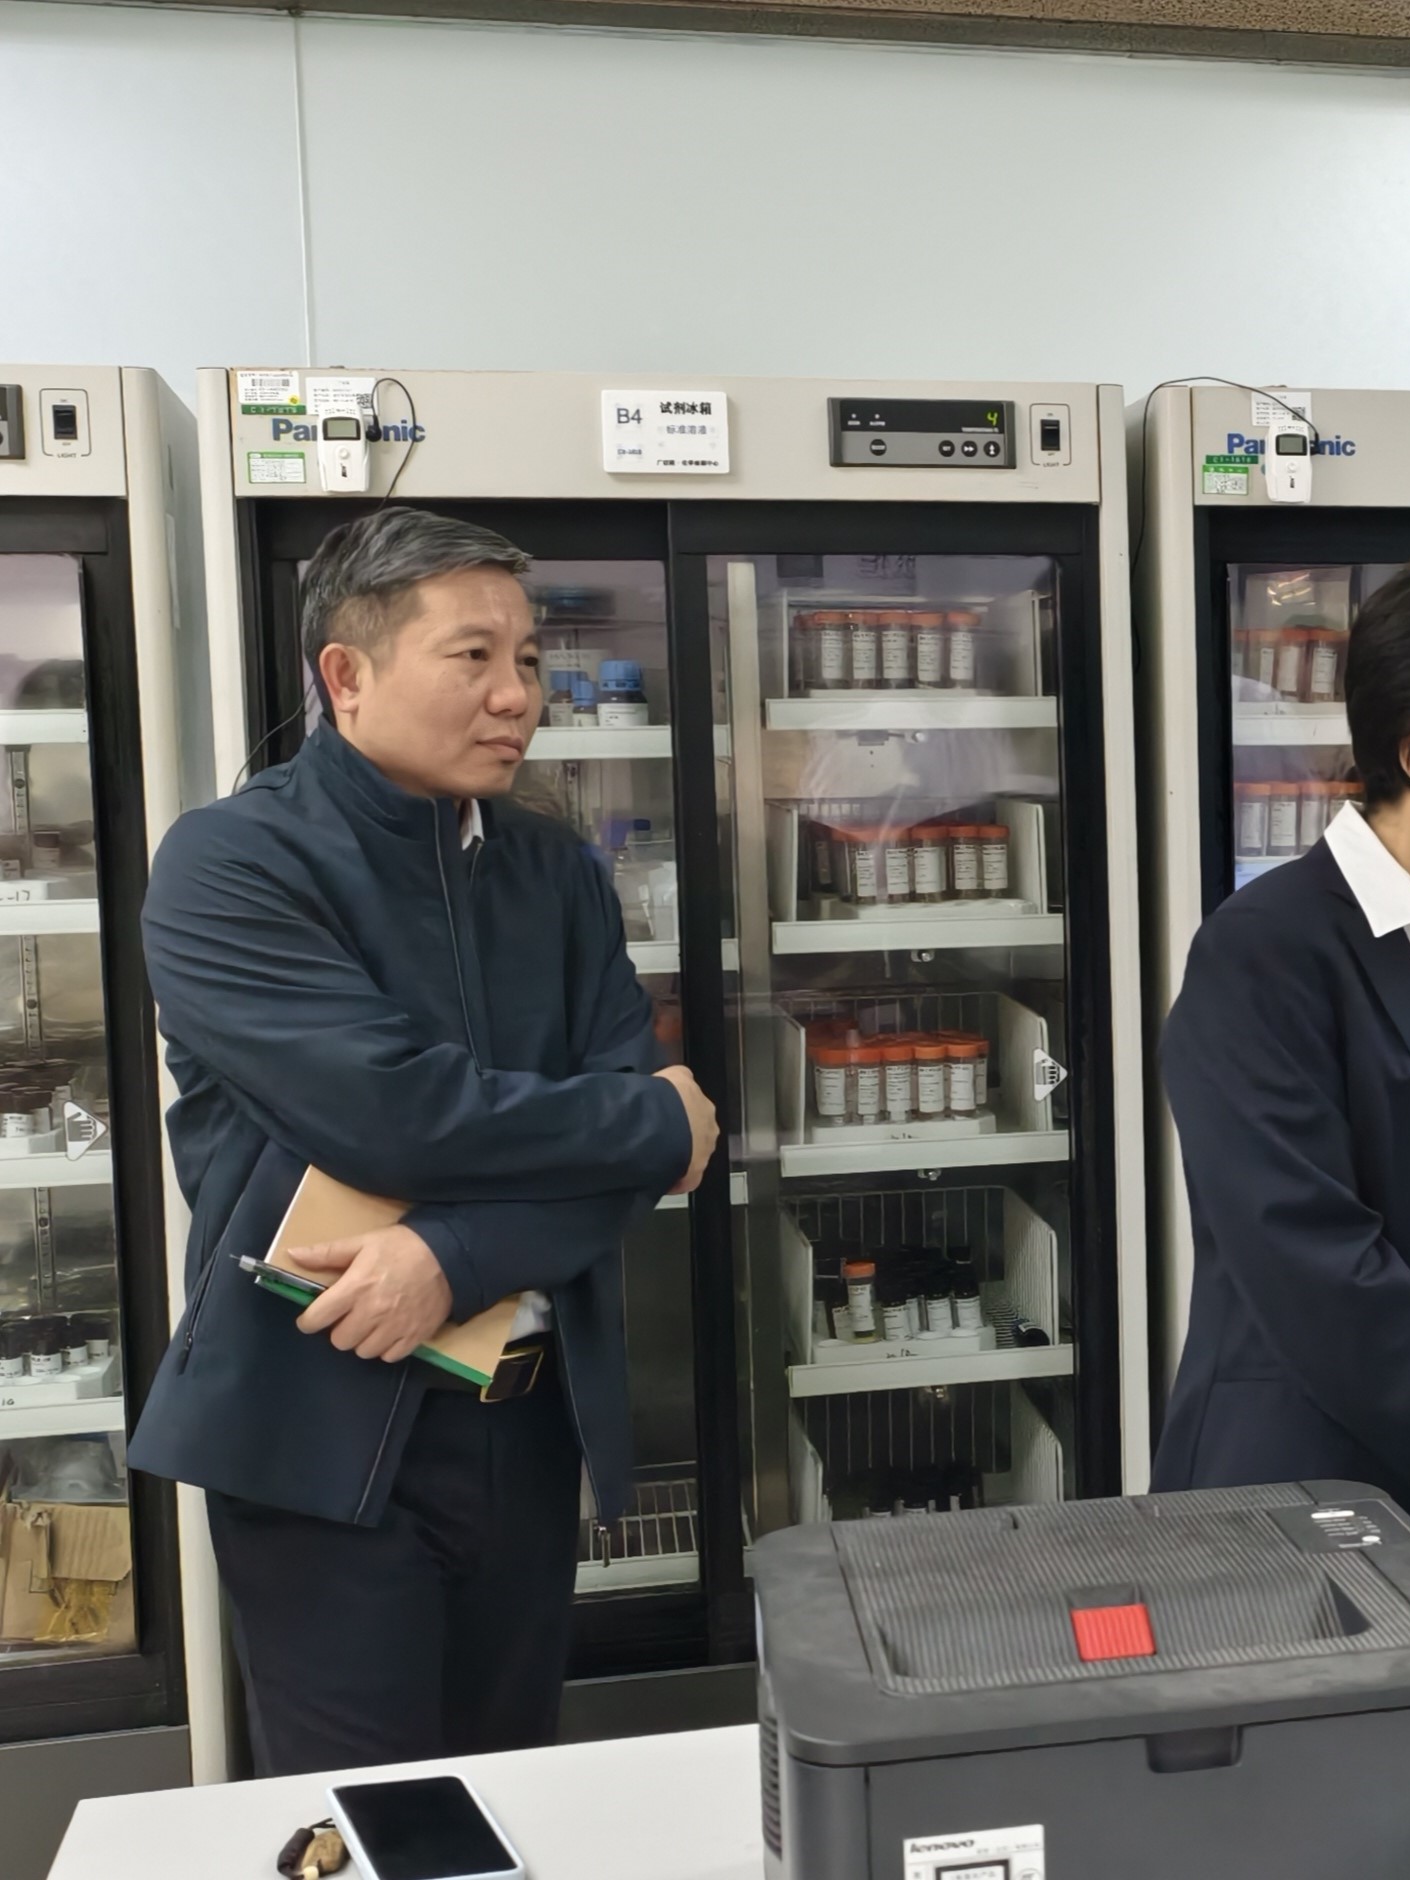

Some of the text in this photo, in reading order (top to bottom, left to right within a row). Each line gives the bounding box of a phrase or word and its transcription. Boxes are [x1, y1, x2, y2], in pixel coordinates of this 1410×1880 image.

[616, 408, 643, 424] B4
[659, 401, 712, 415] 试剂冰箱
[987, 411, 998, 426] 4
[272, 418, 426, 442] Panic
[1227, 433, 1356, 456] Panic
